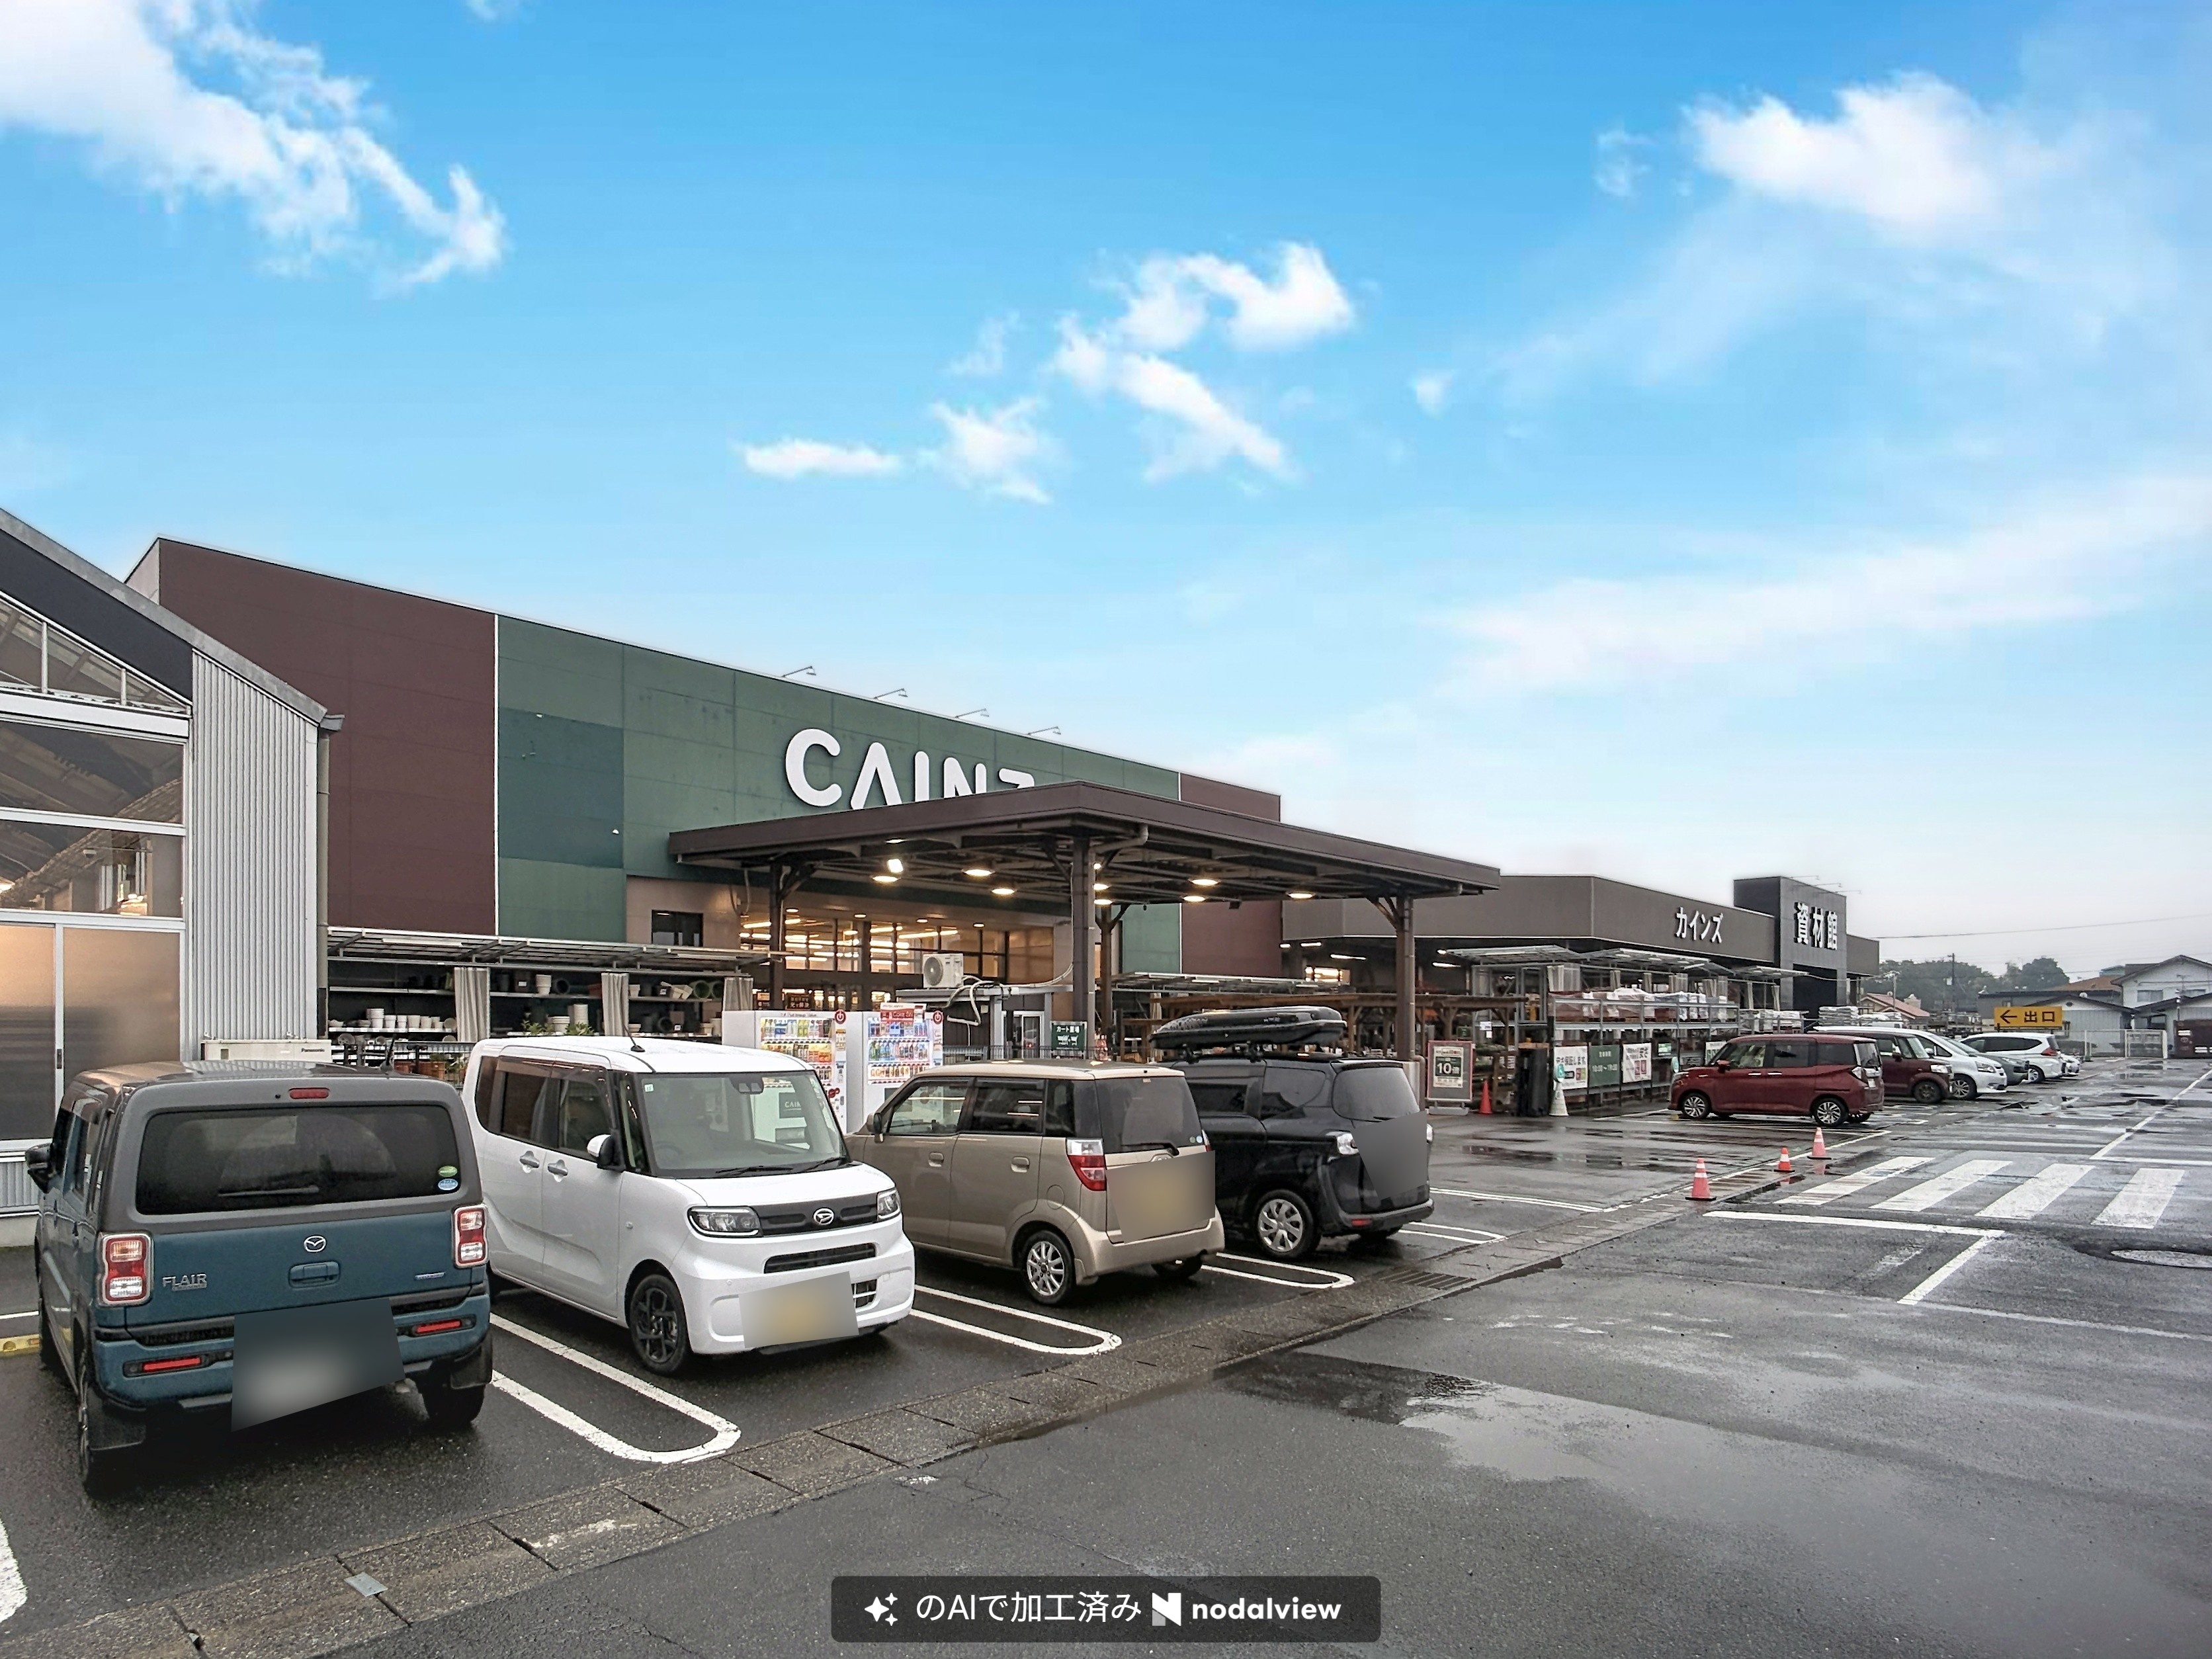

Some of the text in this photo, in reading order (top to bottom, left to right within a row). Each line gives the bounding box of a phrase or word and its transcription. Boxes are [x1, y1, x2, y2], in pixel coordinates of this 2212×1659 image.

[1675, 907, 1724, 944] カインズ
[1794, 902, 1838, 951] 資材館
[2024, 1011, 2055, 1023] 出口
[162, 1273, 207, 1287] FLAIR
